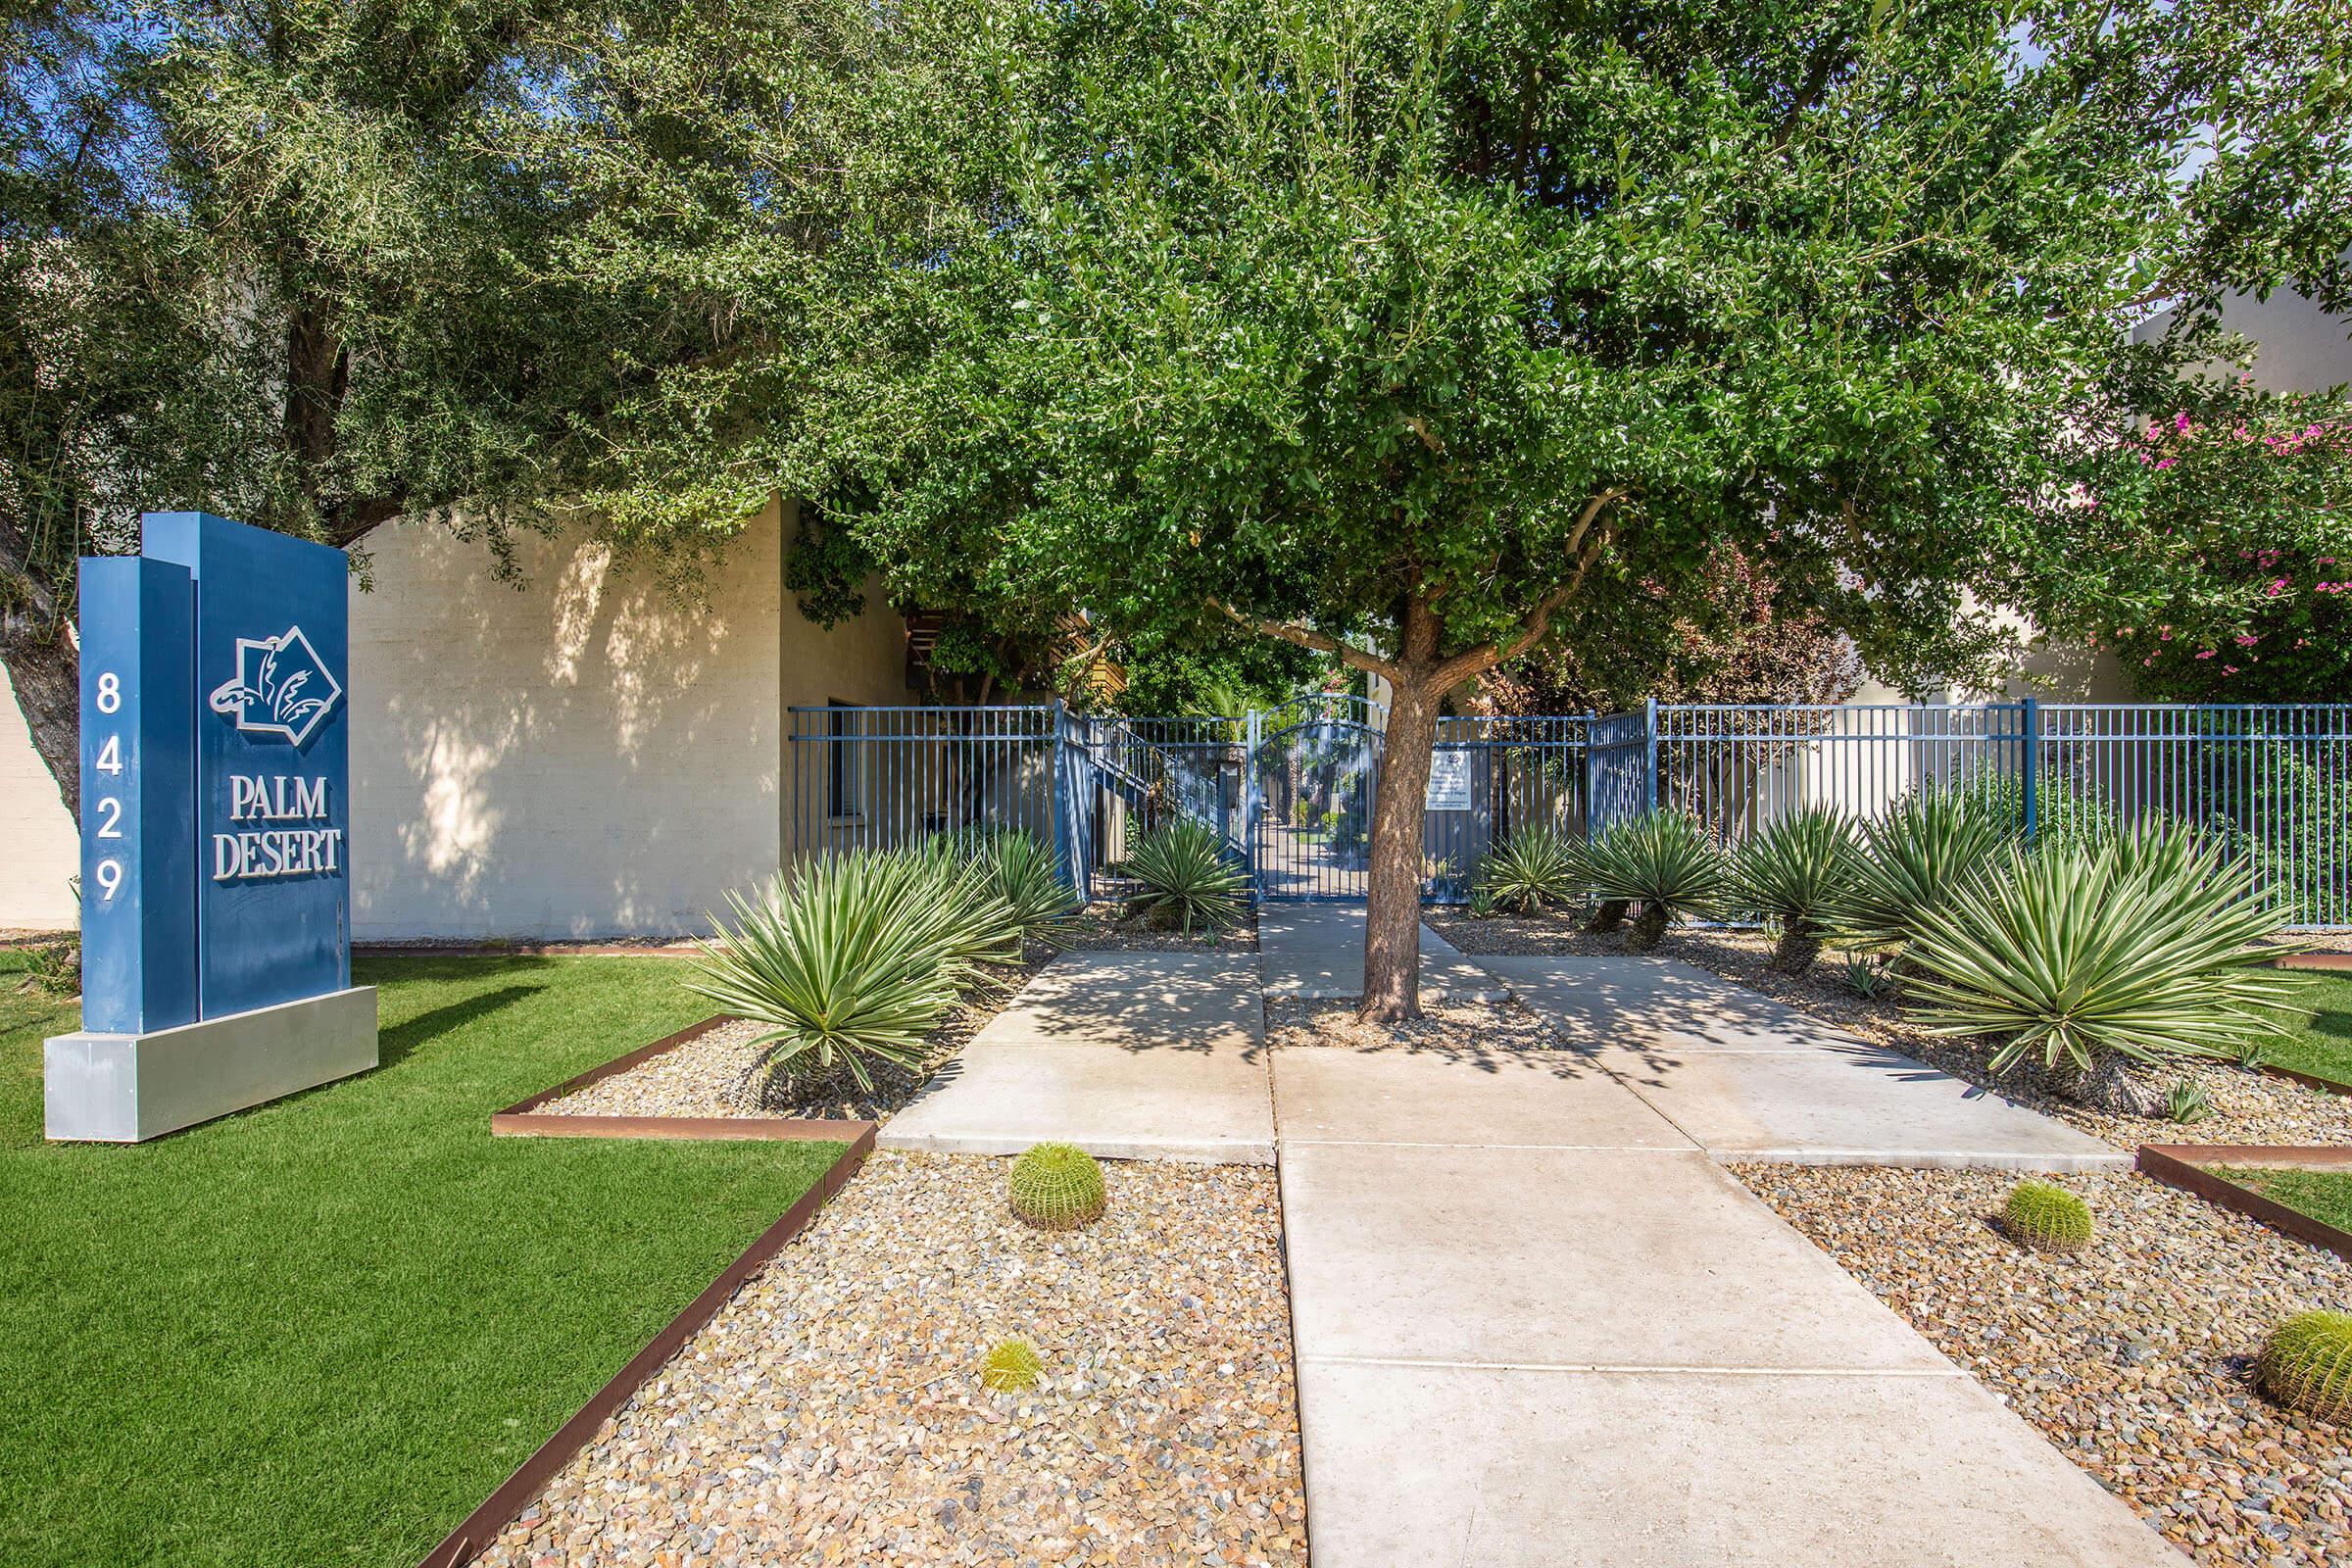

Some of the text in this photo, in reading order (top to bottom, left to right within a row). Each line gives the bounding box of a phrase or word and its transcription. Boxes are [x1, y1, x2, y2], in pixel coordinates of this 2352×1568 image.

[96, 671, 123, 901] 8429
[229, 774, 327, 820] PALM
[213, 829, 342, 881] DESERT
